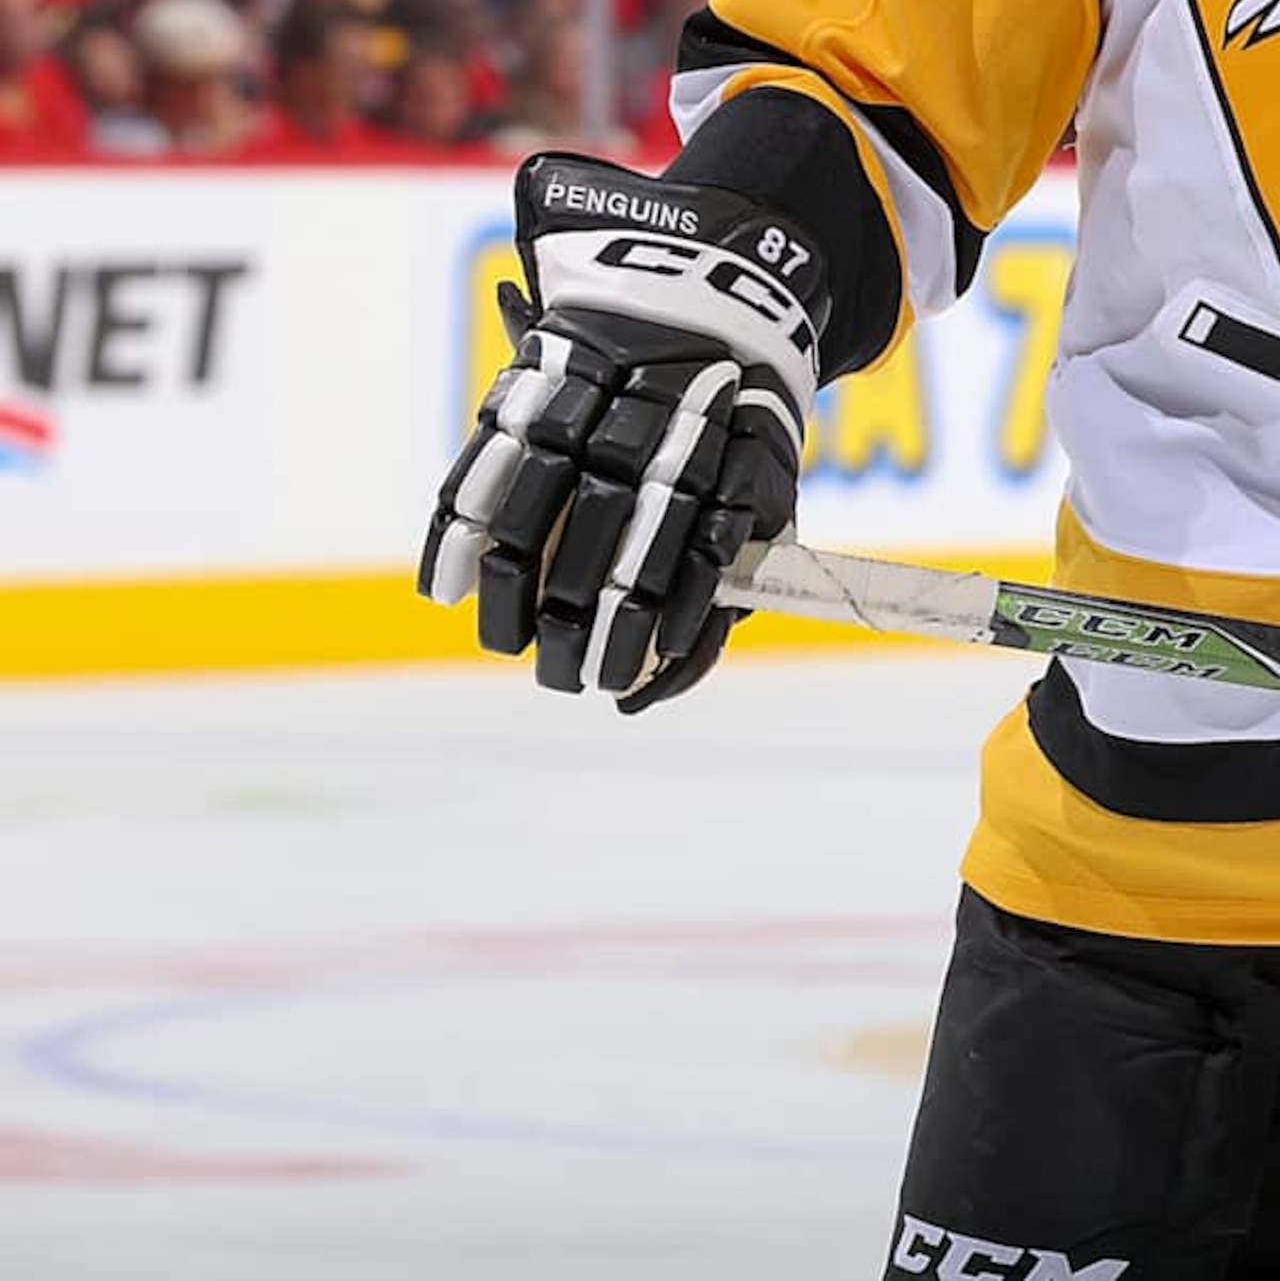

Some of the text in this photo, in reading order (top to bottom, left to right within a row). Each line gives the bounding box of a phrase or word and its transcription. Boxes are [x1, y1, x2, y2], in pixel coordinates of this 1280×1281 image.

[544, 179, 700, 236] PENGUINS
[756, 226, 811, 277] 87
[1016, 599, 1207, 652] CCM
